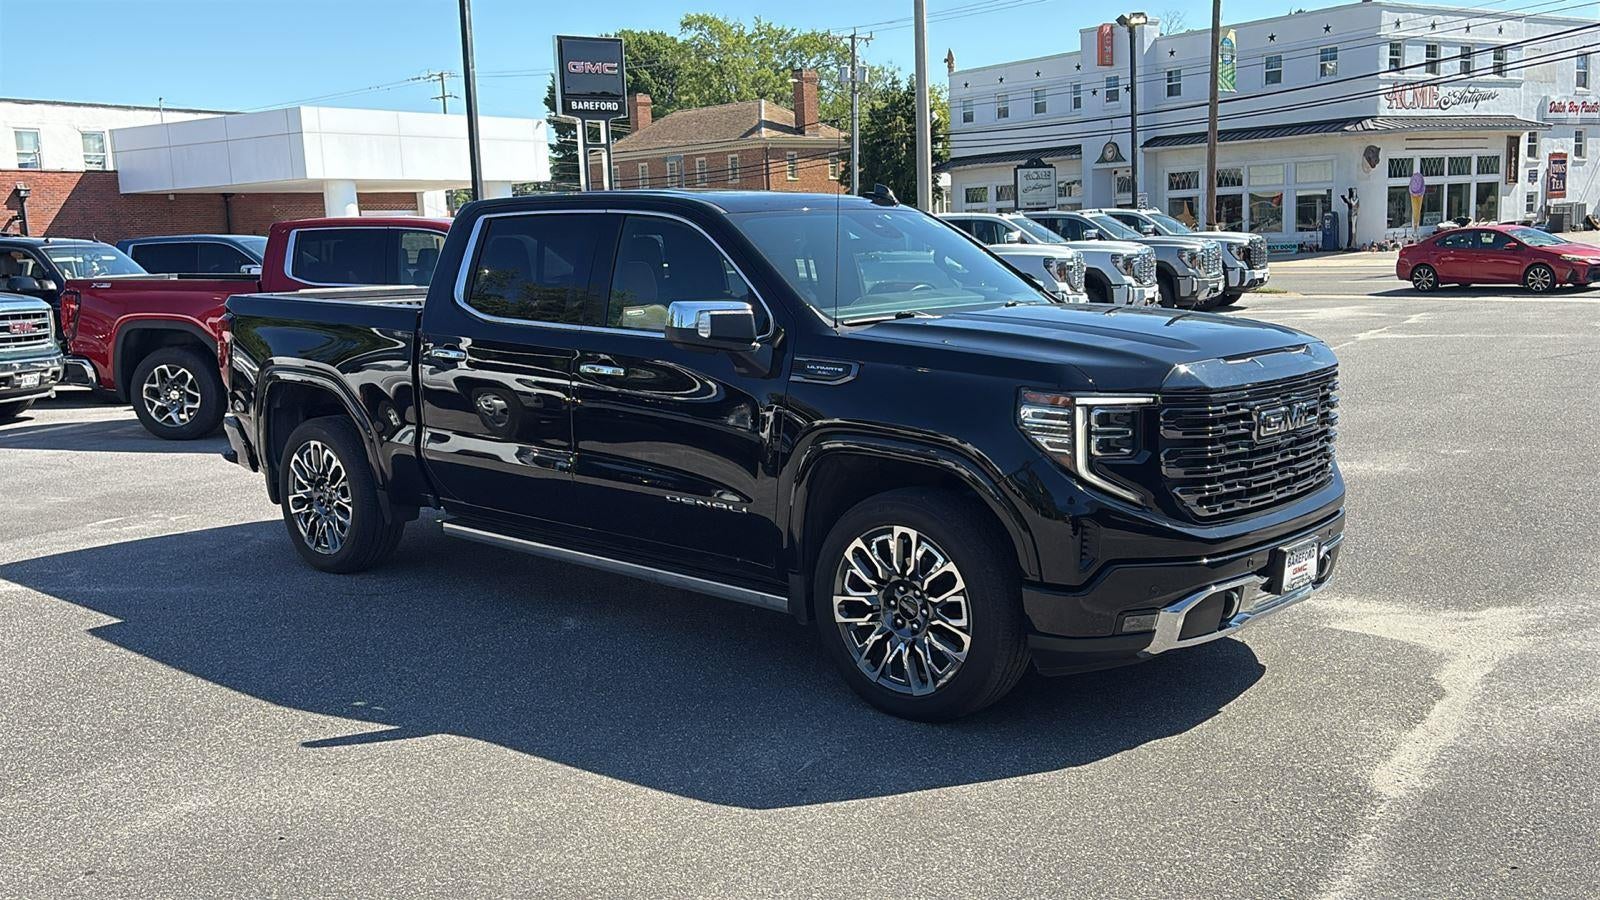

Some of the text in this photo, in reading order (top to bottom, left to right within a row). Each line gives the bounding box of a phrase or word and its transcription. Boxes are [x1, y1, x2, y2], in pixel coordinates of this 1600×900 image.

[568, 61, 618, 74] GMC
[1384, 81, 1499, 110] ACME Antiques
[571, 101, 619, 111] BAREFORD
[1549, 101, 1600, 116] Dutch Boy Paints
[1551, 178, 1564, 190] TEA
[1259, 401, 1318, 436] GMC
[665, 495, 748, 513] DENALI
[1287, 548, 1315, 568] BAREFORD
[1292, 564, 1308, 575] GMC
